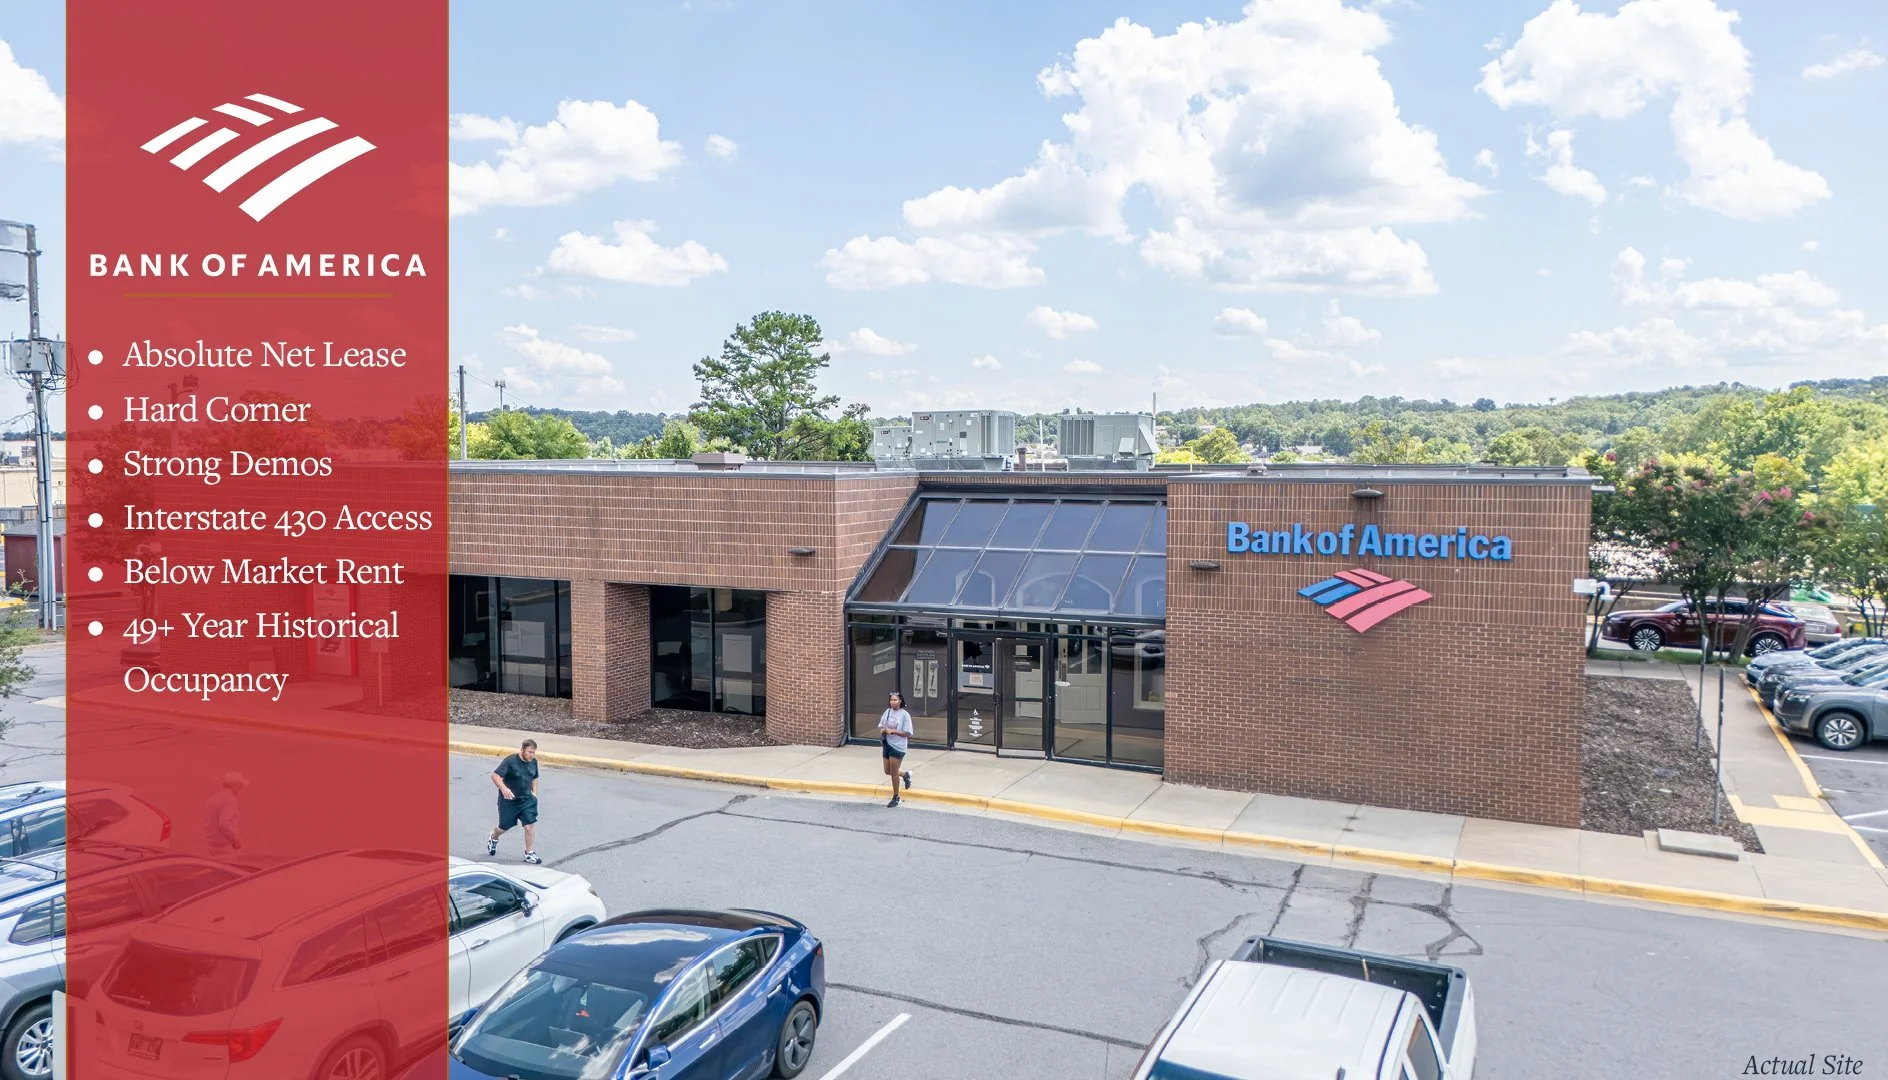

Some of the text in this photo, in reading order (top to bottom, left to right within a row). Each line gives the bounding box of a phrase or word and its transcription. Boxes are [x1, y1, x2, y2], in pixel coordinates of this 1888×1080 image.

[1227, 521, 1513, 562] Bank of America
